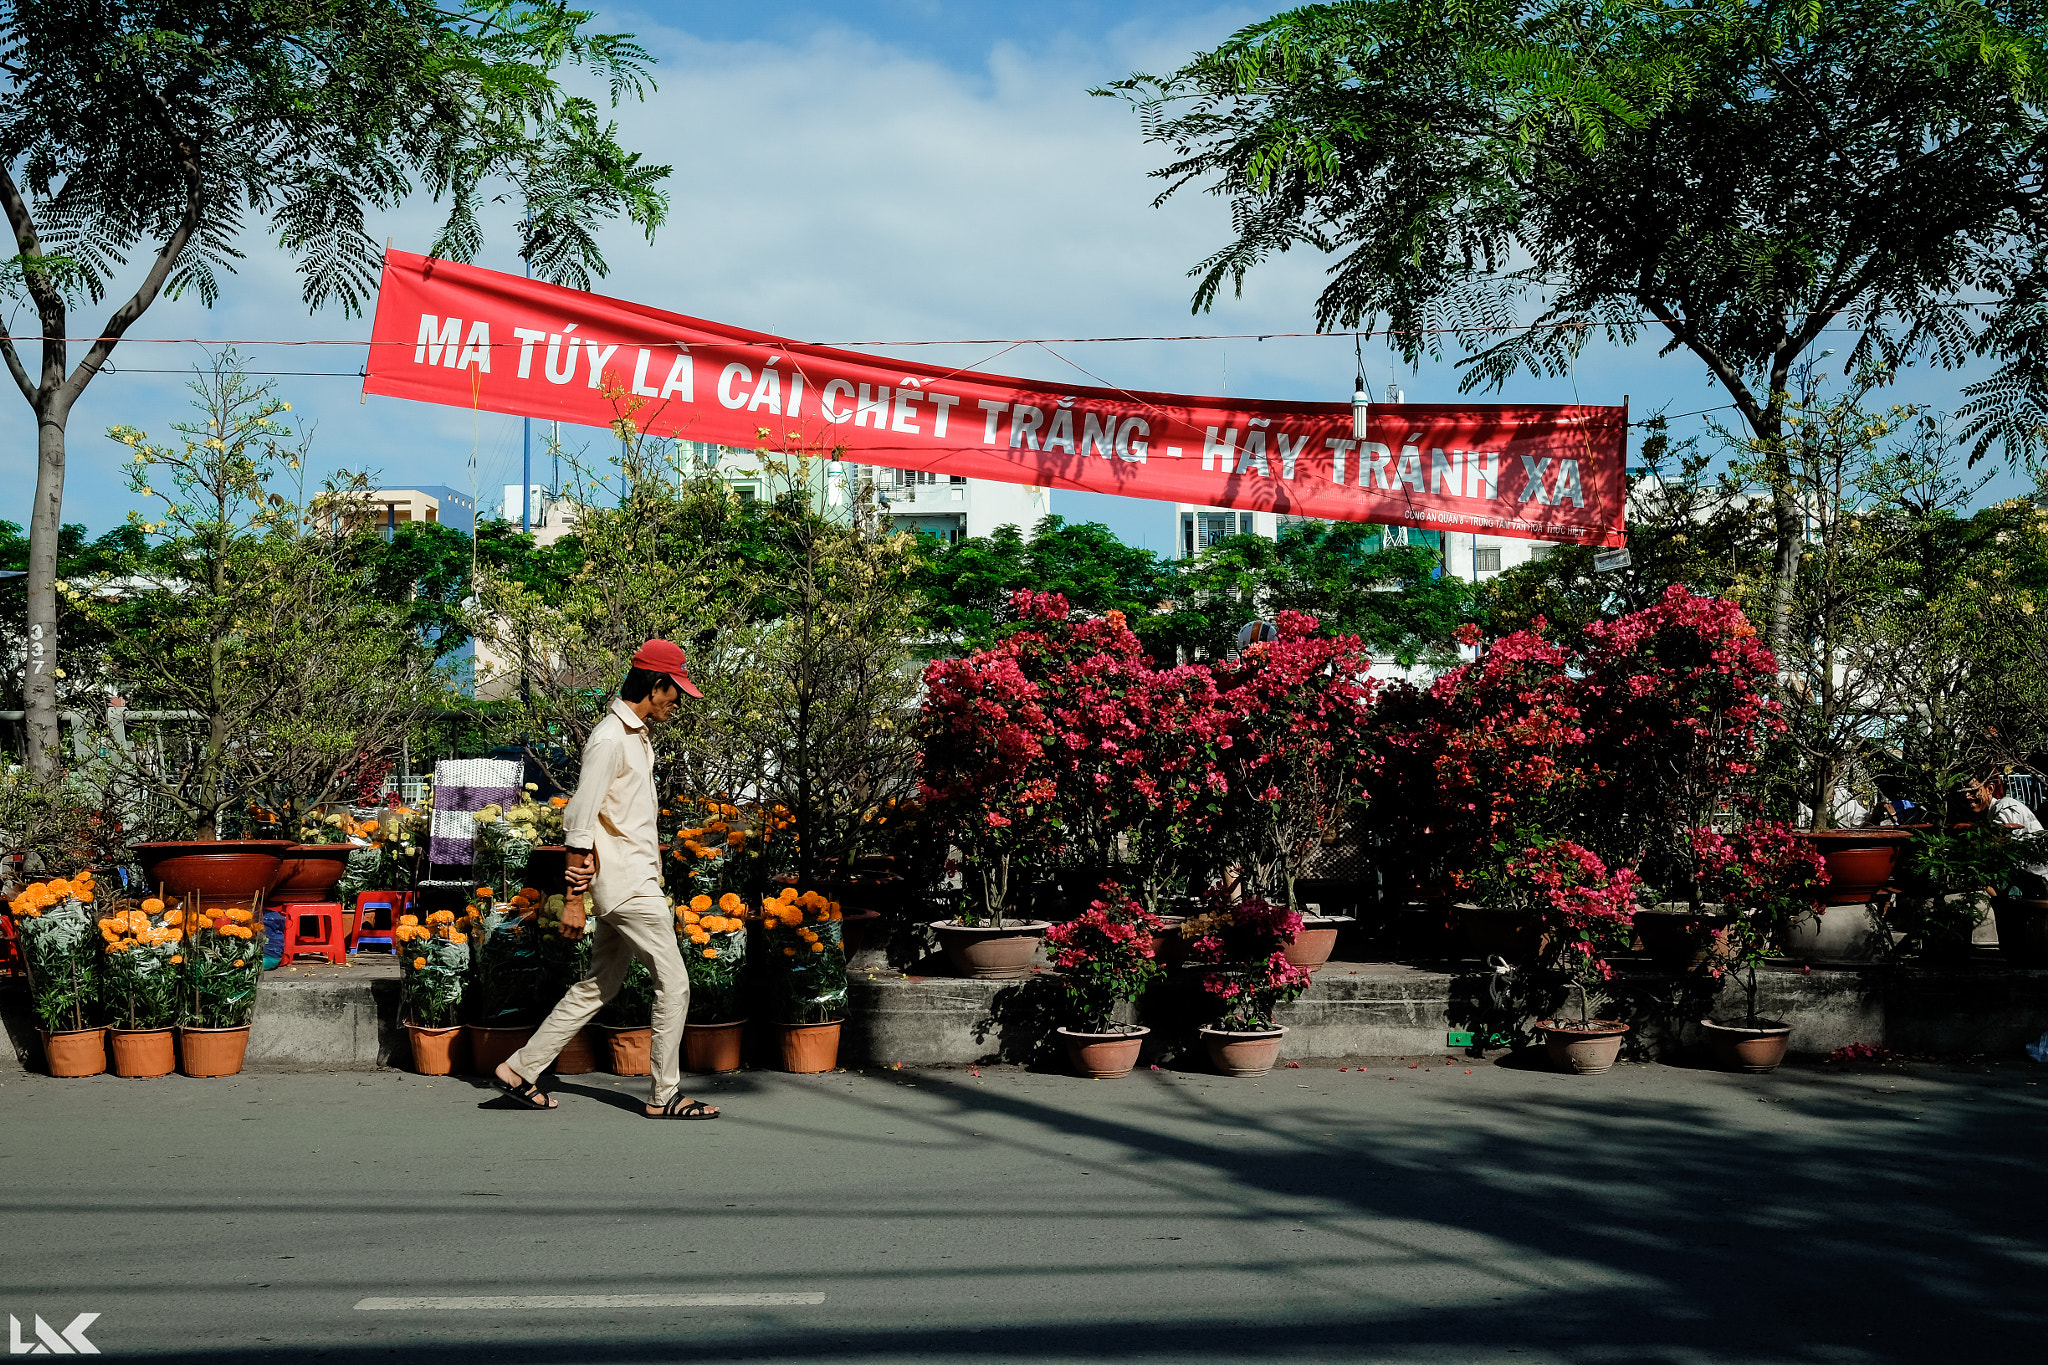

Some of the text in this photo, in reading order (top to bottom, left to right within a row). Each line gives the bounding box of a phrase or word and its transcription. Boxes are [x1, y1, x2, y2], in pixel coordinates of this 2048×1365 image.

[414, 313, 491, 374] MA
[513, 323, 620, 390] TÚY
[631, 340, 695, 403] LÀ
[717, 356, 804, 418] CÁI
[821, 377, 960, 439] CHẾT
[977, 396, 1151, 465] TRẮNG
[1201, 418, 1310, 480] HÃY
[1325, 432, 1499, 500] TRÁNH
[1517, 454, 1585, 508] XA
[1426, 511, 1437, 522] AN
[30, 623, 45, 675] 337
